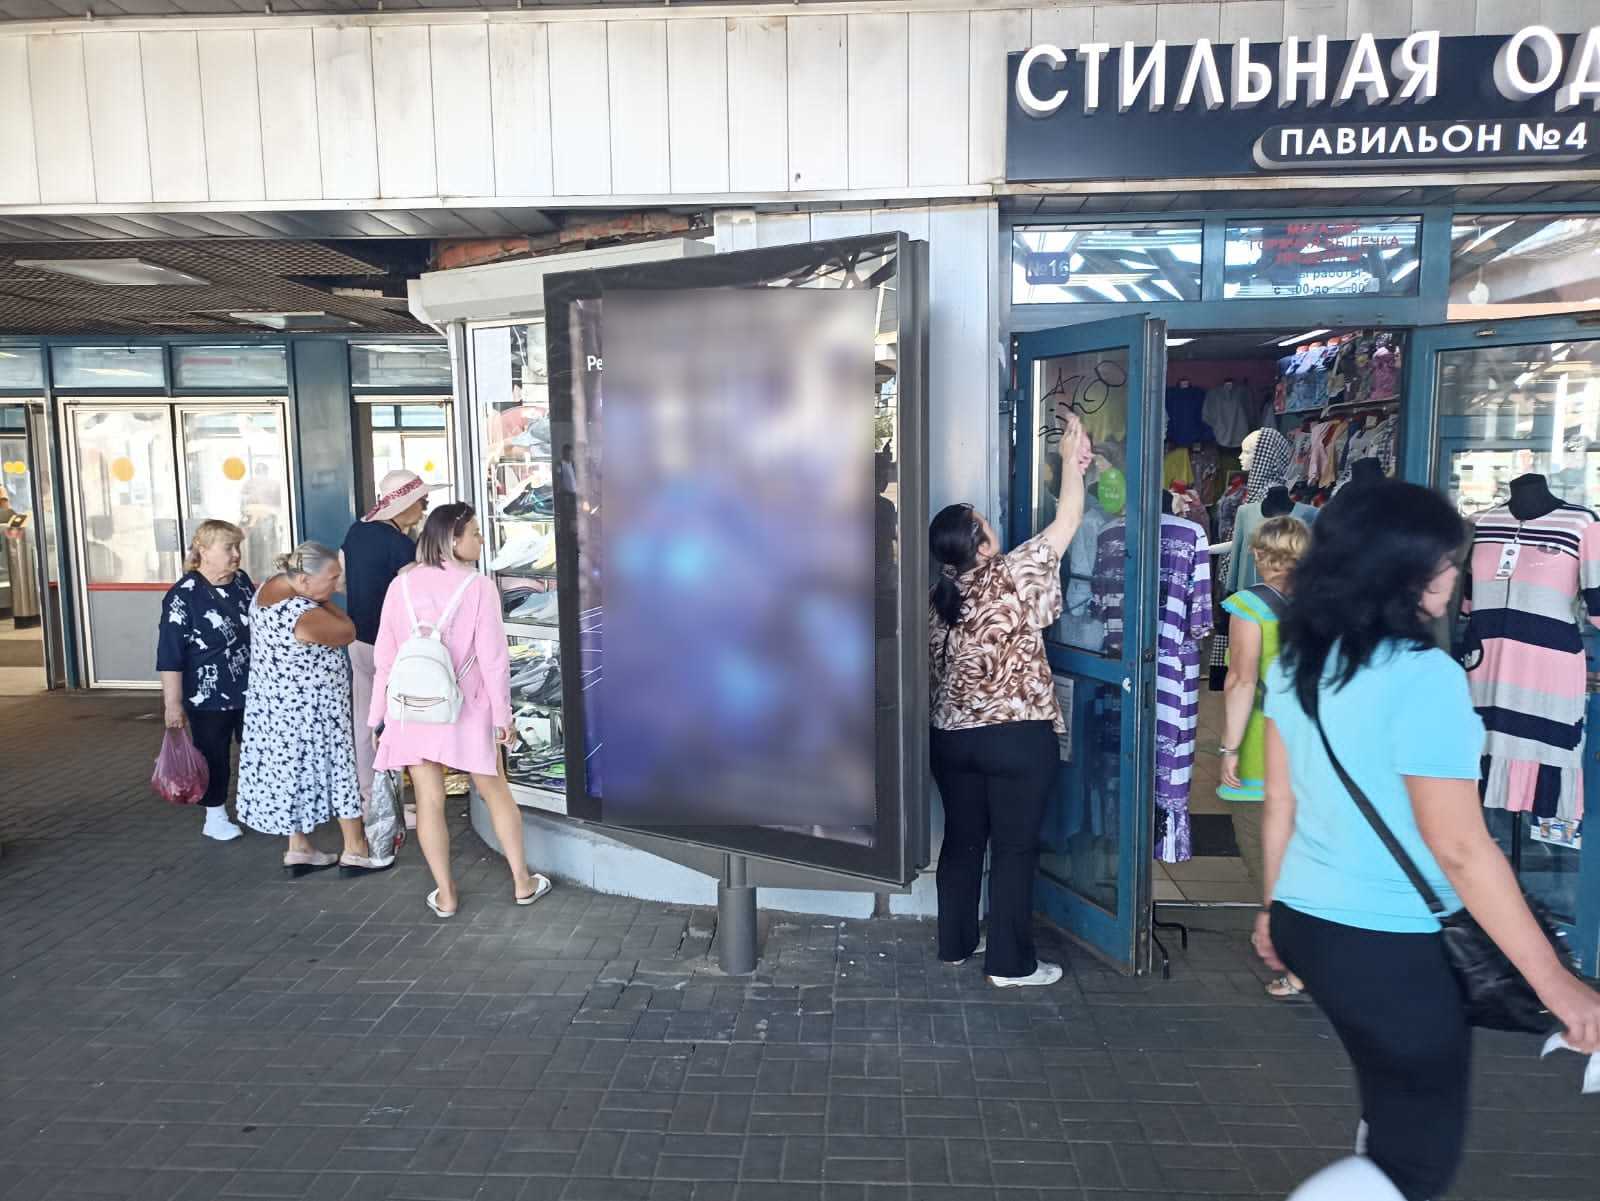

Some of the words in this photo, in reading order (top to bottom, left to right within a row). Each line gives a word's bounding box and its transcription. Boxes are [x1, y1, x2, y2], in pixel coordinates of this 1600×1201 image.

[1016, 30, 1441, 116] СТИЛЬНАЯ
[1280, 124, 1502, 156] ПАВИЛЬОН
[1518, 122, 1588, 150] №4
